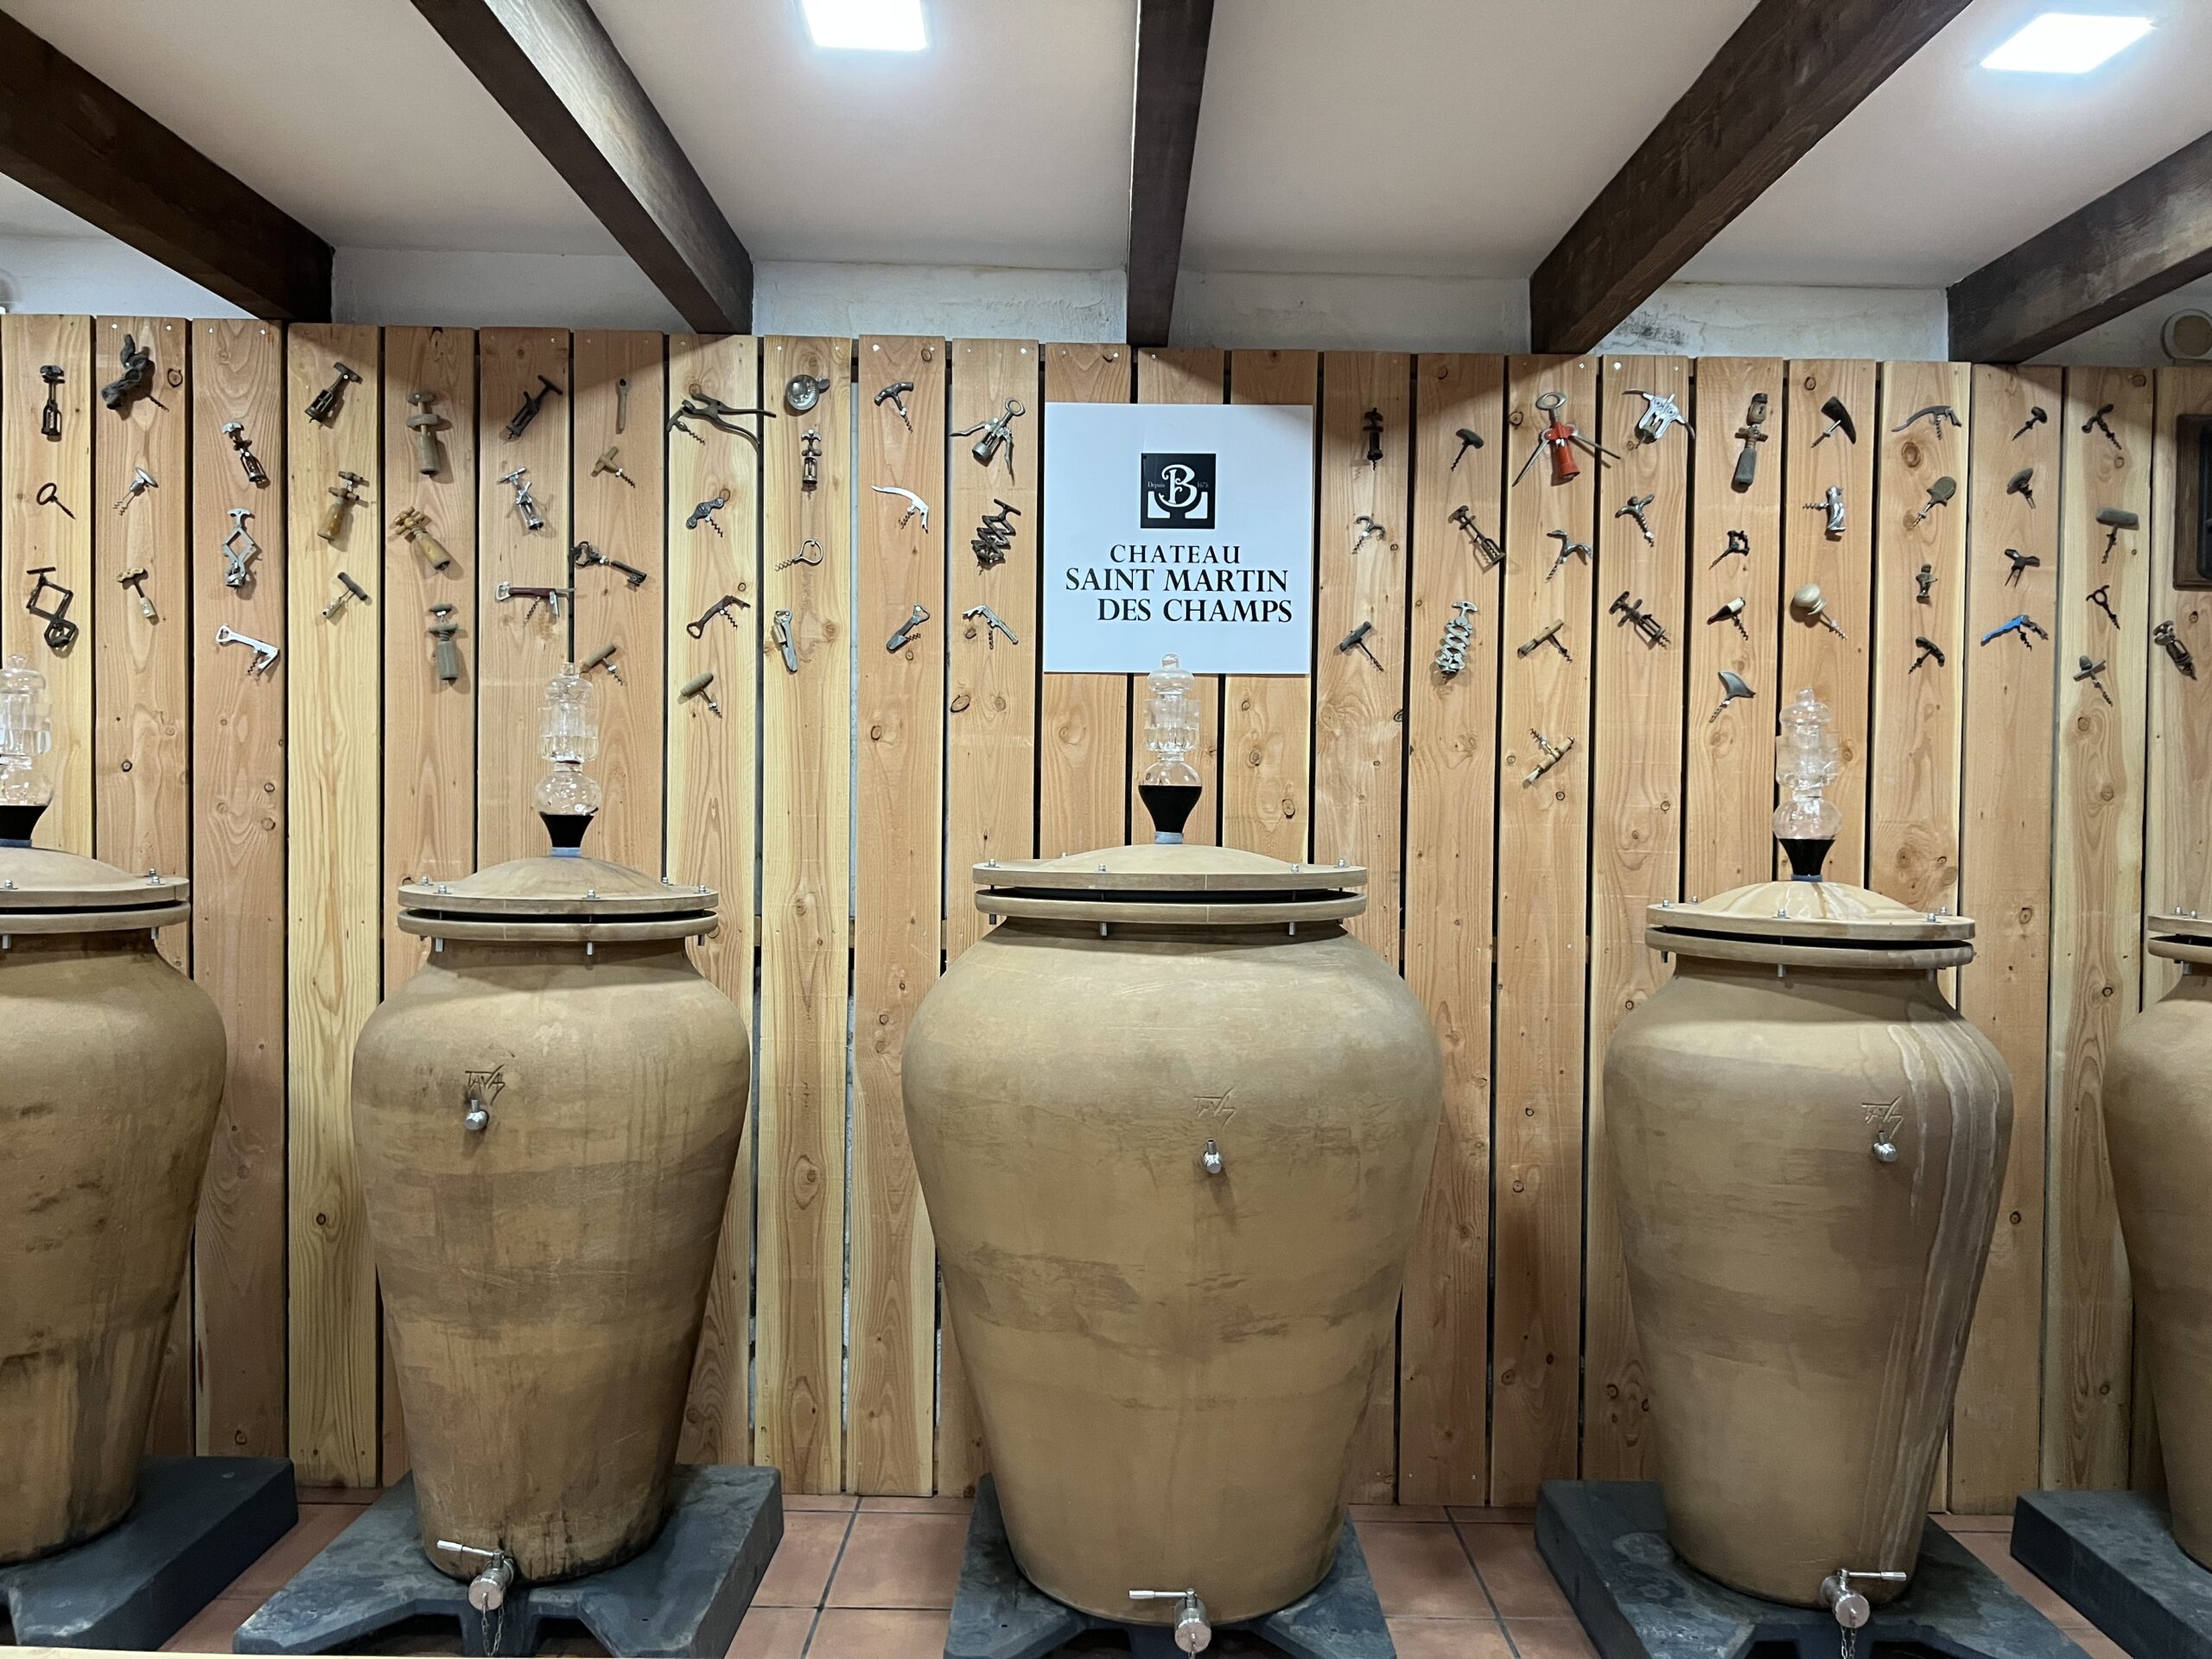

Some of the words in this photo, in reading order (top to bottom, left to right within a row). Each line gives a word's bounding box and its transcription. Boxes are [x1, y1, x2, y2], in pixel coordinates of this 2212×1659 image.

[1109, 544, 1241, 564] CHATEAU
[1065, 567, 1155, 591] SAINT
[1163, 569, 1289, 593] MARTIN
[1097, 598, 1152, 622] DES
[1163, 598, 1293, 623] CHAMPS
